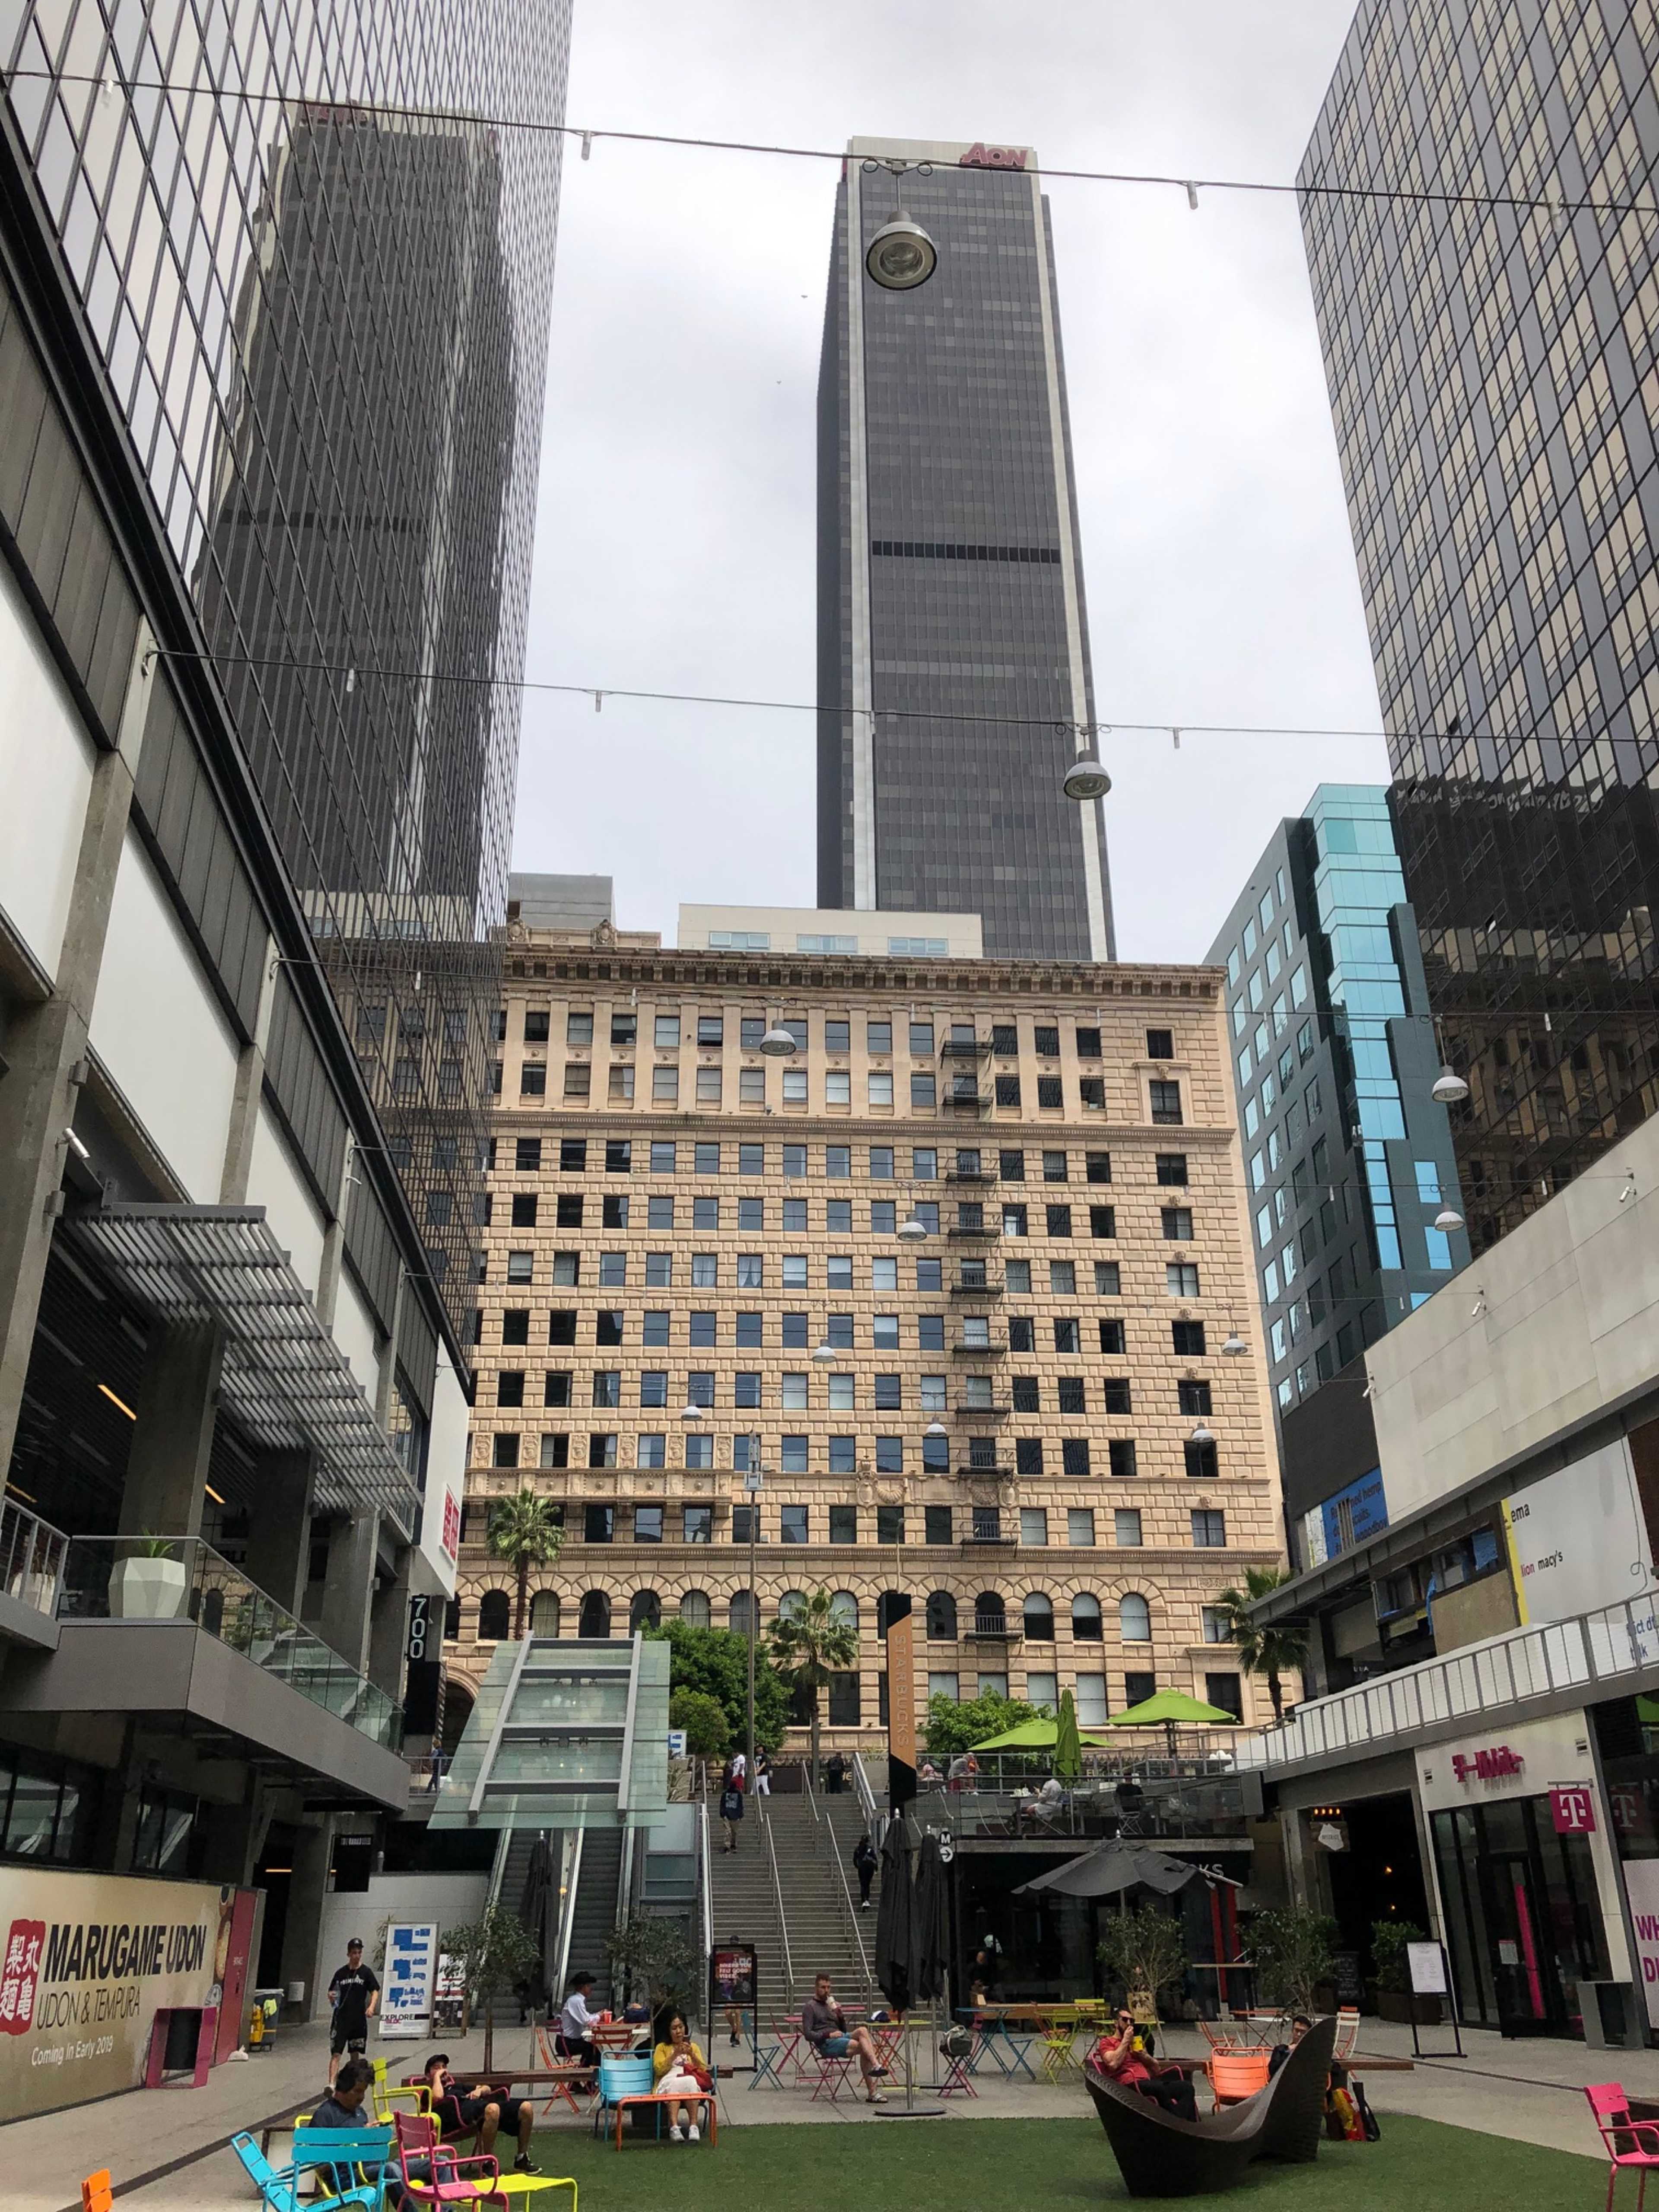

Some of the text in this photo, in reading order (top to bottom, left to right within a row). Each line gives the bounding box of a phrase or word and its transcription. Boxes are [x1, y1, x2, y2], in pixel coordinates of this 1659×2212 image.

[1538, 1550, 1563, 1570] macy's
[410, 1598, 427, 1659] 700
[895, 1635, 909, 1747] STARBUCKS
[941, 1833, 950, 1844] M
[44, 1924, 207, 1983] MARUGAME UDON
[37, 1986, 141, 2030] UDON & TEMPURA
[31, 2044, 64, 2066] Coming
[75, 2038, 96, 2059] Early
[96, 2035, 114, 2055] 2019
